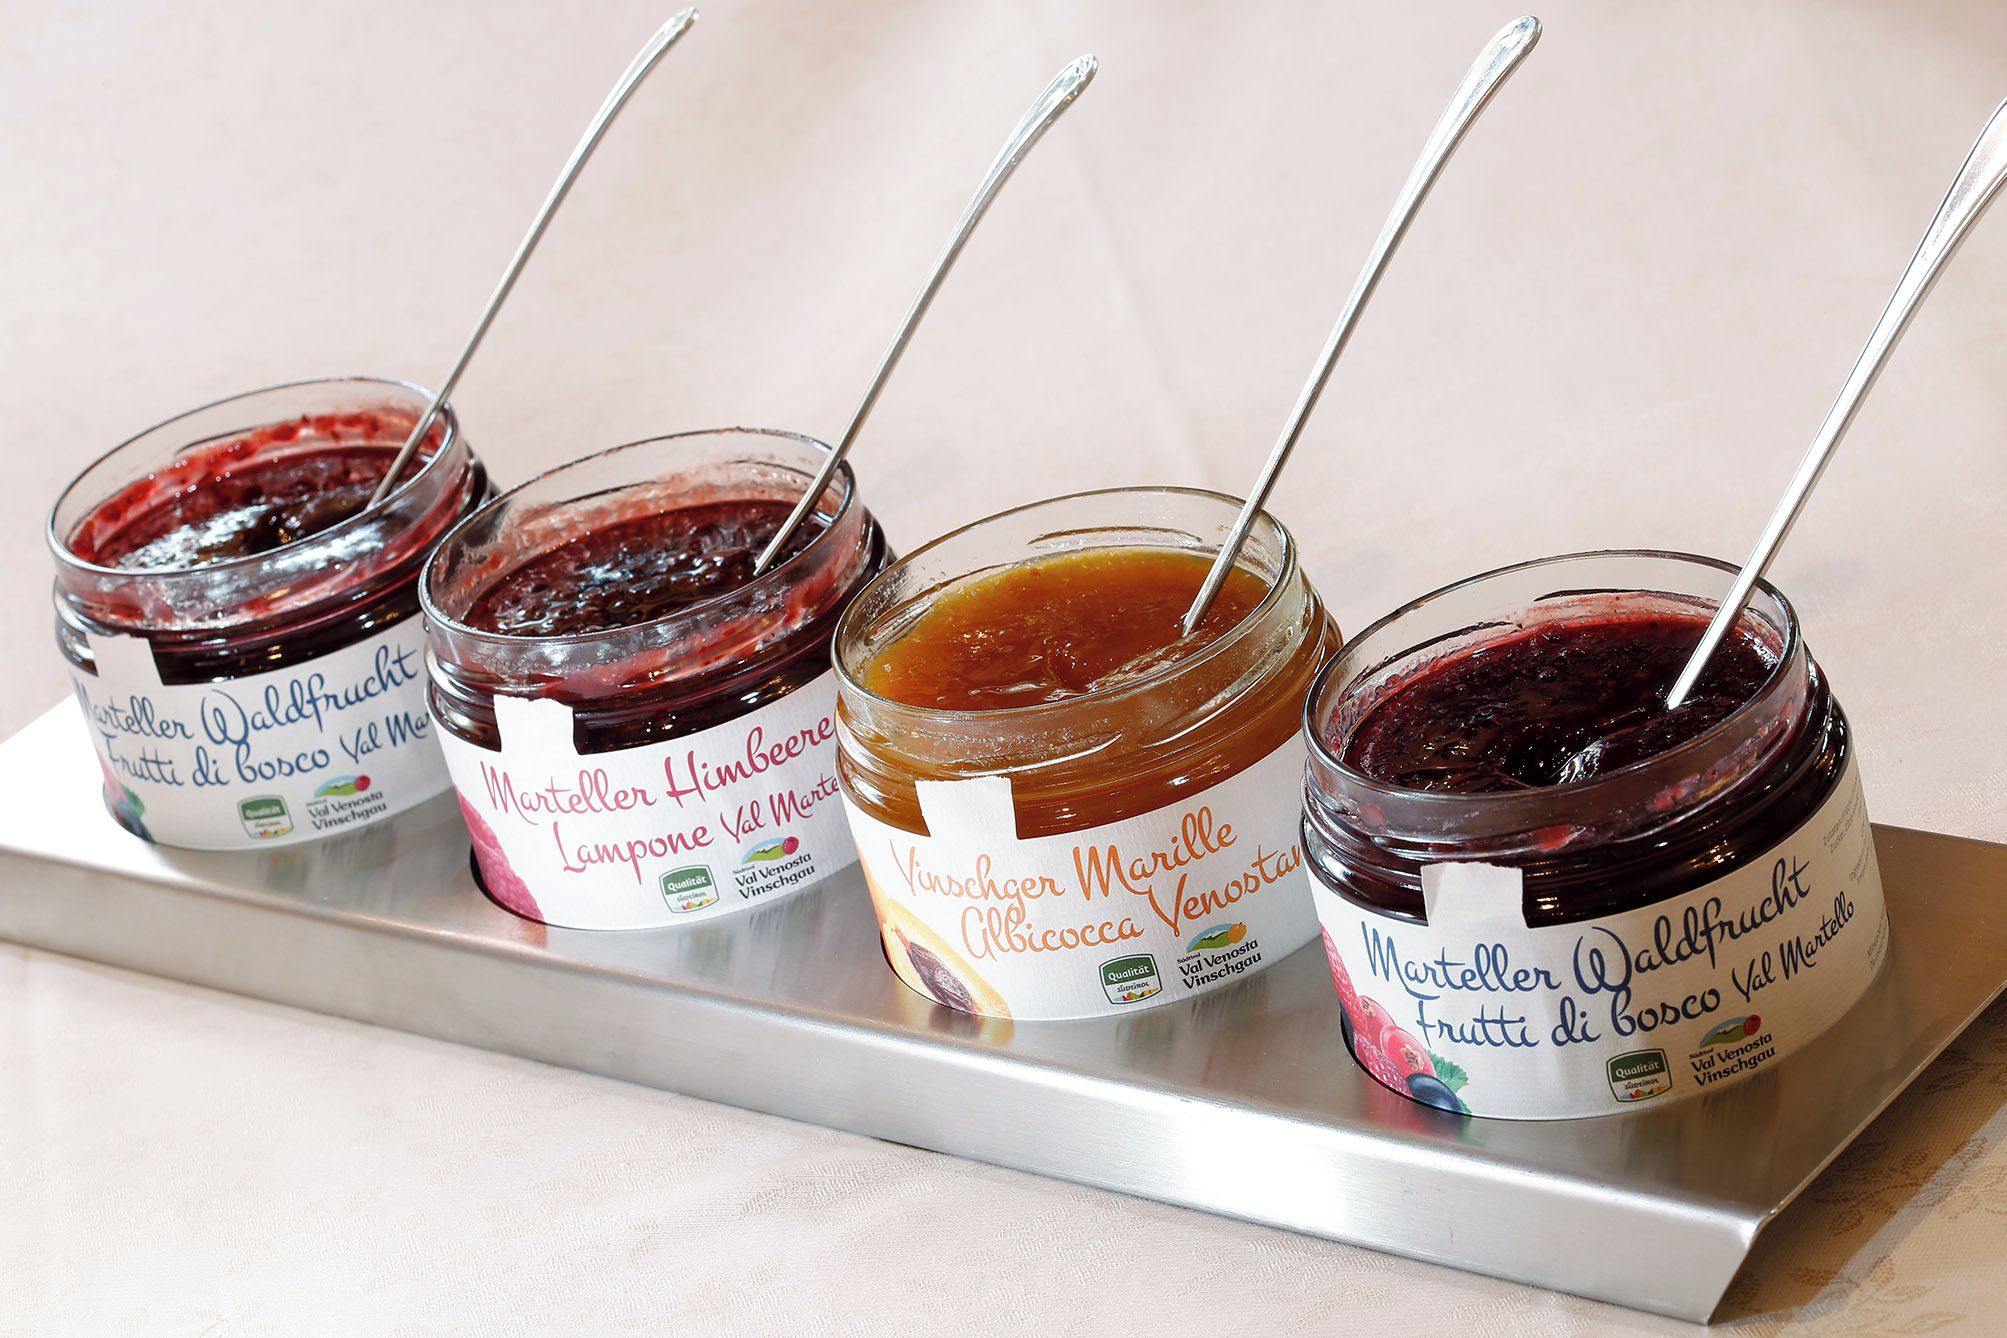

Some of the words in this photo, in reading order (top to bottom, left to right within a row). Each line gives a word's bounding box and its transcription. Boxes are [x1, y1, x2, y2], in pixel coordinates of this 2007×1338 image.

[201, 644, 418, 746] Waldfrucht
[101, 731, 184, 786] Frutti
[192, 746, 229, 787] di
[236, 740, 330, 785] bosco
[340, 722, 383, 764] Val
[480, 760, 657, 825] Marteller
[664, 717, 835, 808] Himbeere
[308, 807, 330, 819] Val
[331, 790, 384, 812] Venosta
[312, 803, 388, 831] Vinschgau
[553, 821, 715, 885] Lampone
[719, 800, 767, 844] Val
[889, 837, 1066, 914] Vinschger
[1073, 806, 1238, 903] Marille
[667, 875, 707, 891] Qualität
[735, 872, 757, 887] Val
[759, 853, 812, 879] Venosta
[738, 864, 816, 899] Vinschgau
[961, 904, 1144, 961] Albicocca
[1361, 920, 1562, 1000] Marteller
[1573, 855, 1812, 996] Waldfrucht
[1108, 964, 1150, 981] Qualität
[1178, 959, 1203, 976] Val
[1204, 938, 1259, 968] Venosta
[1182, 952, 1262, 989] Vinschgau
[1405, 992, 1539, 1051] Frutti
[1551, 996, 1603, 1047] di
[1610, 987, 1721, 1038] bosco
[1732, 954, 1776, 1003] Val
[1781, 891, 1855, 981] Martello
[1615, 1060, 1660, 1079] Qualität
[1690, 1056, 1716, 1073] Val
[1717, 1033, 1773, 1063] Venosta
[1694, 1047, 1776, 1087] Vinschgau
